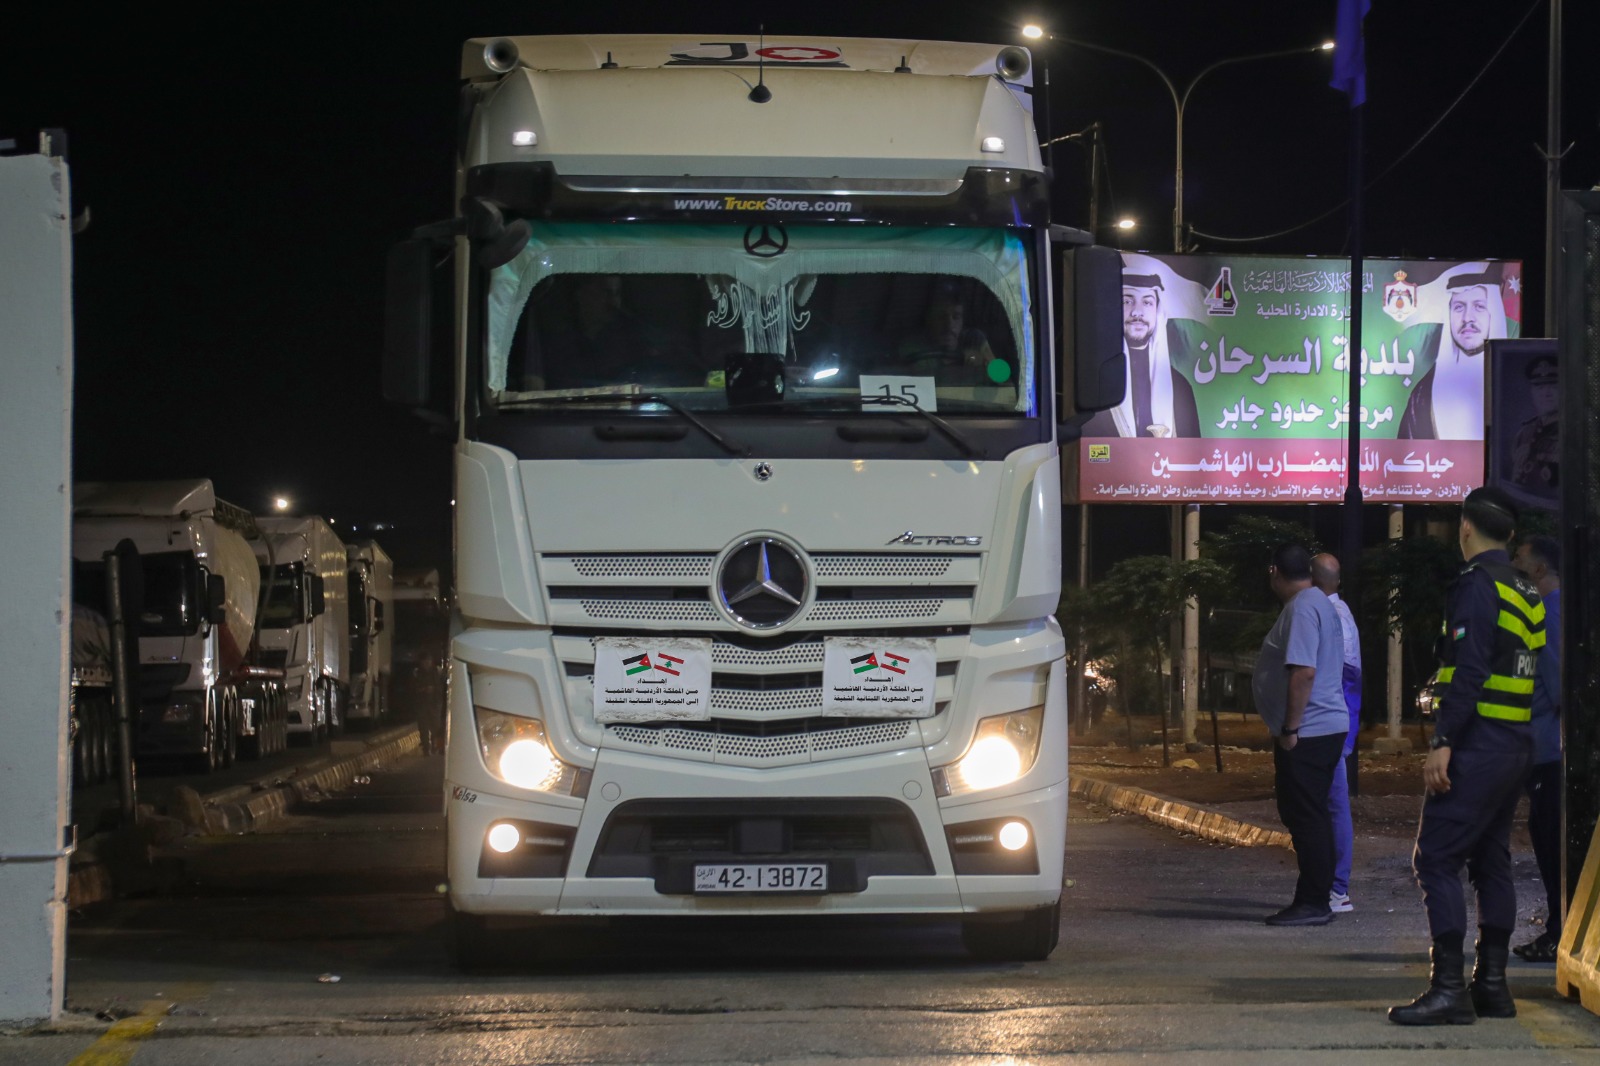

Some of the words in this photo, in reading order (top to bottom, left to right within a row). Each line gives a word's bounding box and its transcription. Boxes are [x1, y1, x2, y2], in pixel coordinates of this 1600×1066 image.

[674, 196, 852, 212] www.TruckStore.com
[1257, 303, 1291, 319] المحلية
[1331, 303, 1352, 320] زارة
[1194, 336, 1321, 385] السرحان
[879, 384, 919, 406] 15
[1216, 395, 1265, 430] جابر
[1270, 399, 1324, 430] حدود
[1327, 395, 1394, 430] مركز
[1384, 451, 1455, 479] حياكم
[1162, 484, 1181, 498] وطن
[1223, 484, 1242, 498] يقود
[1243, 482, 1266, 498] وحيث
[1301, 484, 1323, 498] كرم
[1323, 487, 1335, 499] مع
[1414, 482, 1433, 498] حيث
[718, 866, 823, 888] 42-13872
